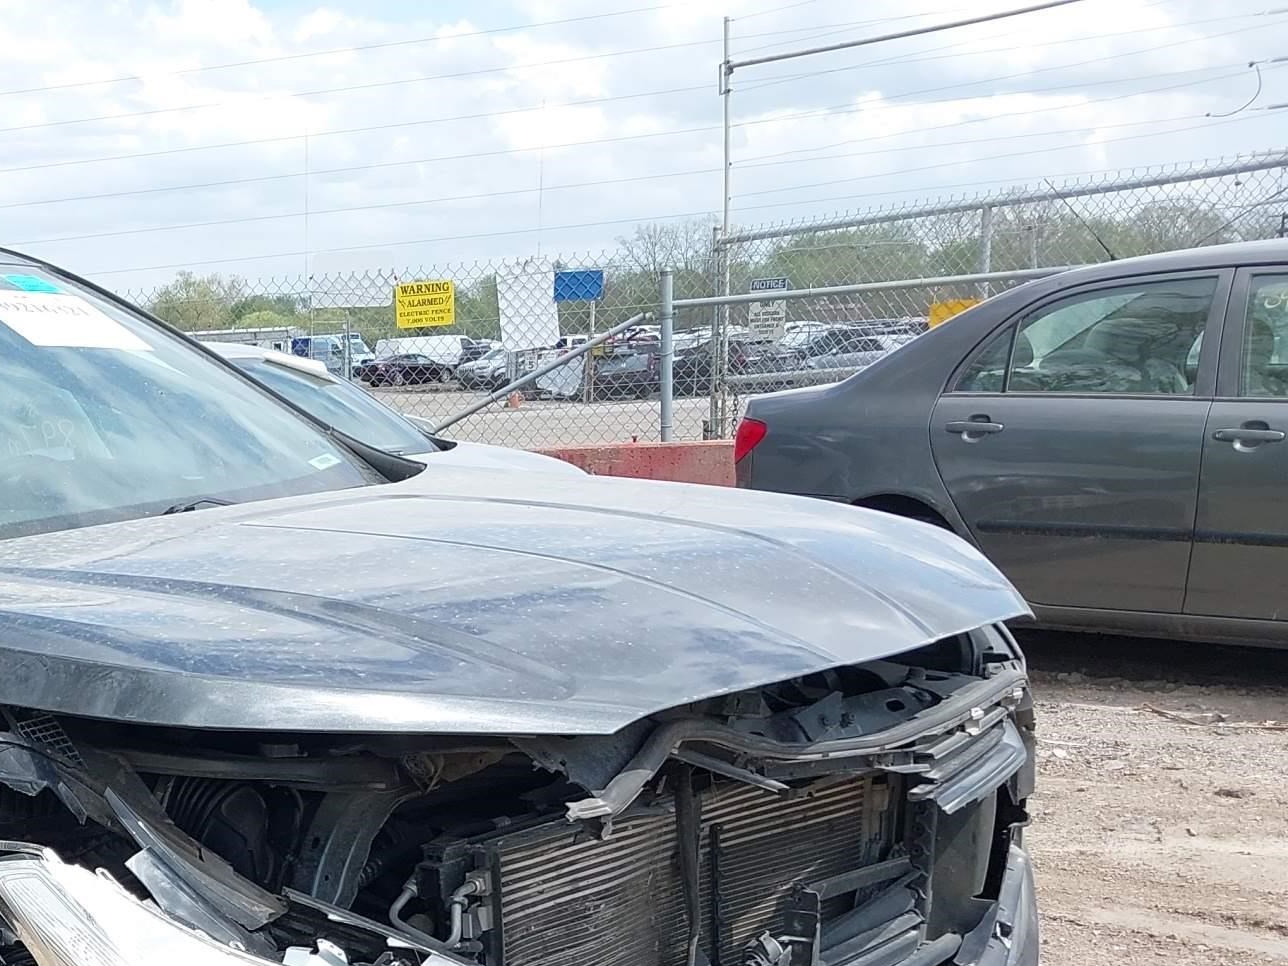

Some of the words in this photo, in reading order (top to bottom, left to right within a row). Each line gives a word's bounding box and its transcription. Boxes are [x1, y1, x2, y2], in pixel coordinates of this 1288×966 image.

[399, 282, 450, 295] WARNING
[753, 279, 785, 289] NOTICE
[407, 297, 444, 308] ALARMED
[399, 310, 430, 318] ELECTRIC
